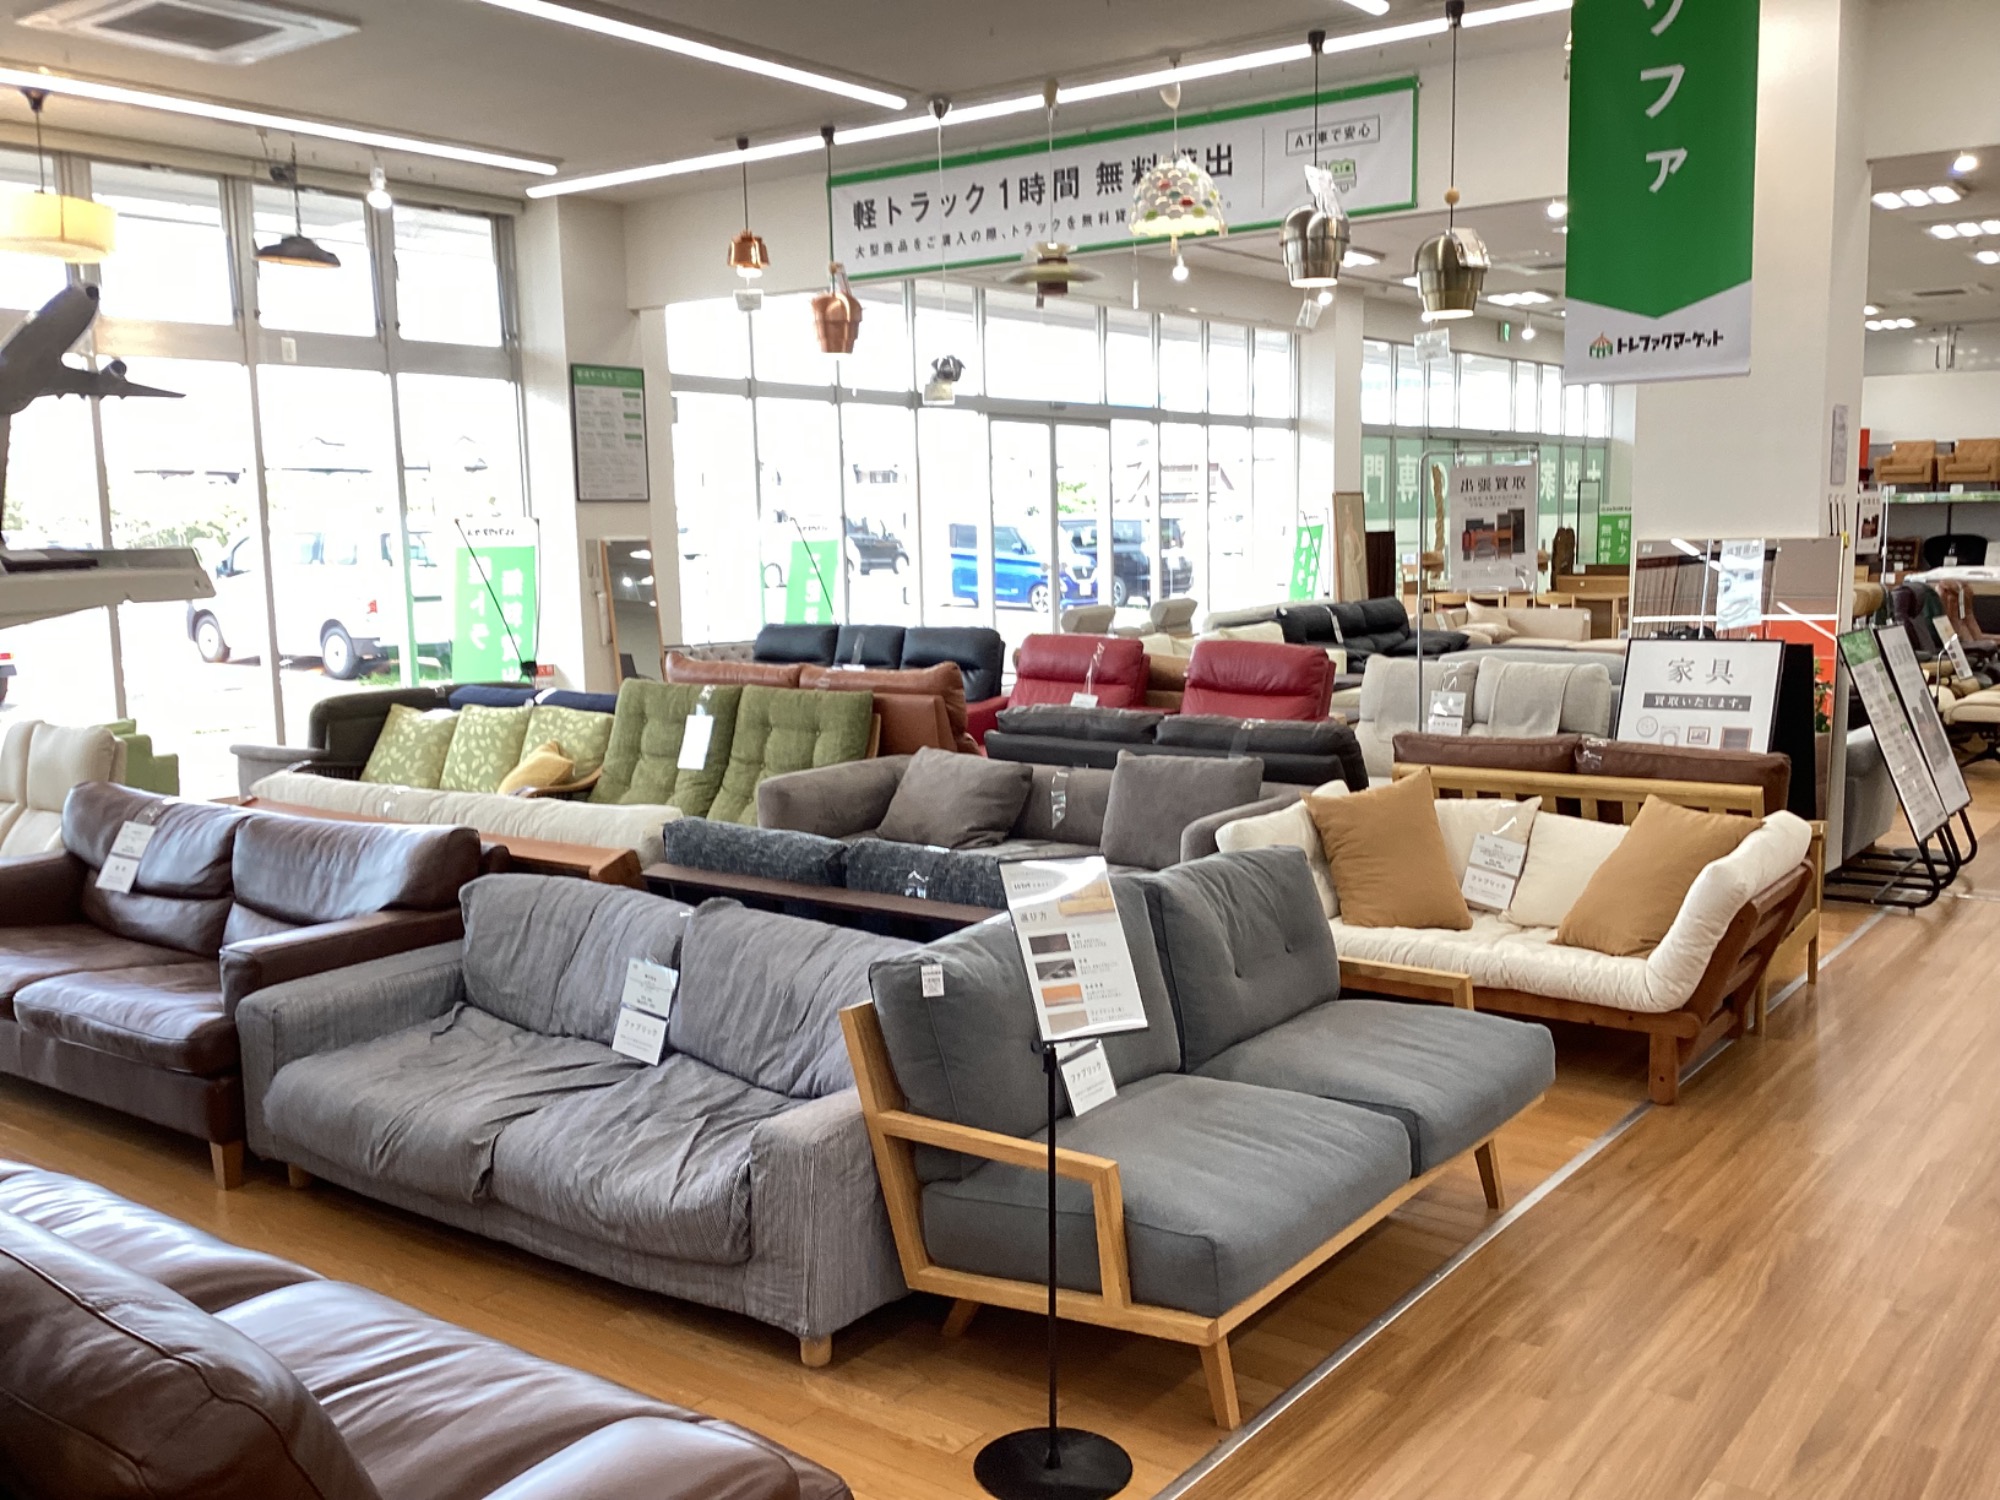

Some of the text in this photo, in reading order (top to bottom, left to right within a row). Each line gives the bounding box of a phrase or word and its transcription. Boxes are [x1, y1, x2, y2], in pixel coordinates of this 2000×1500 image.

[1294, 123, 1371, 148] AT車で安心
[853, 143, 1233, 231] 軽トラック1時間 無料出
[1617, 329, 1724, 354] トレファクマーケット
[1668, 657, 1734, 686] 家具
[1653, 694, 1744, 710] 買取いたします。
